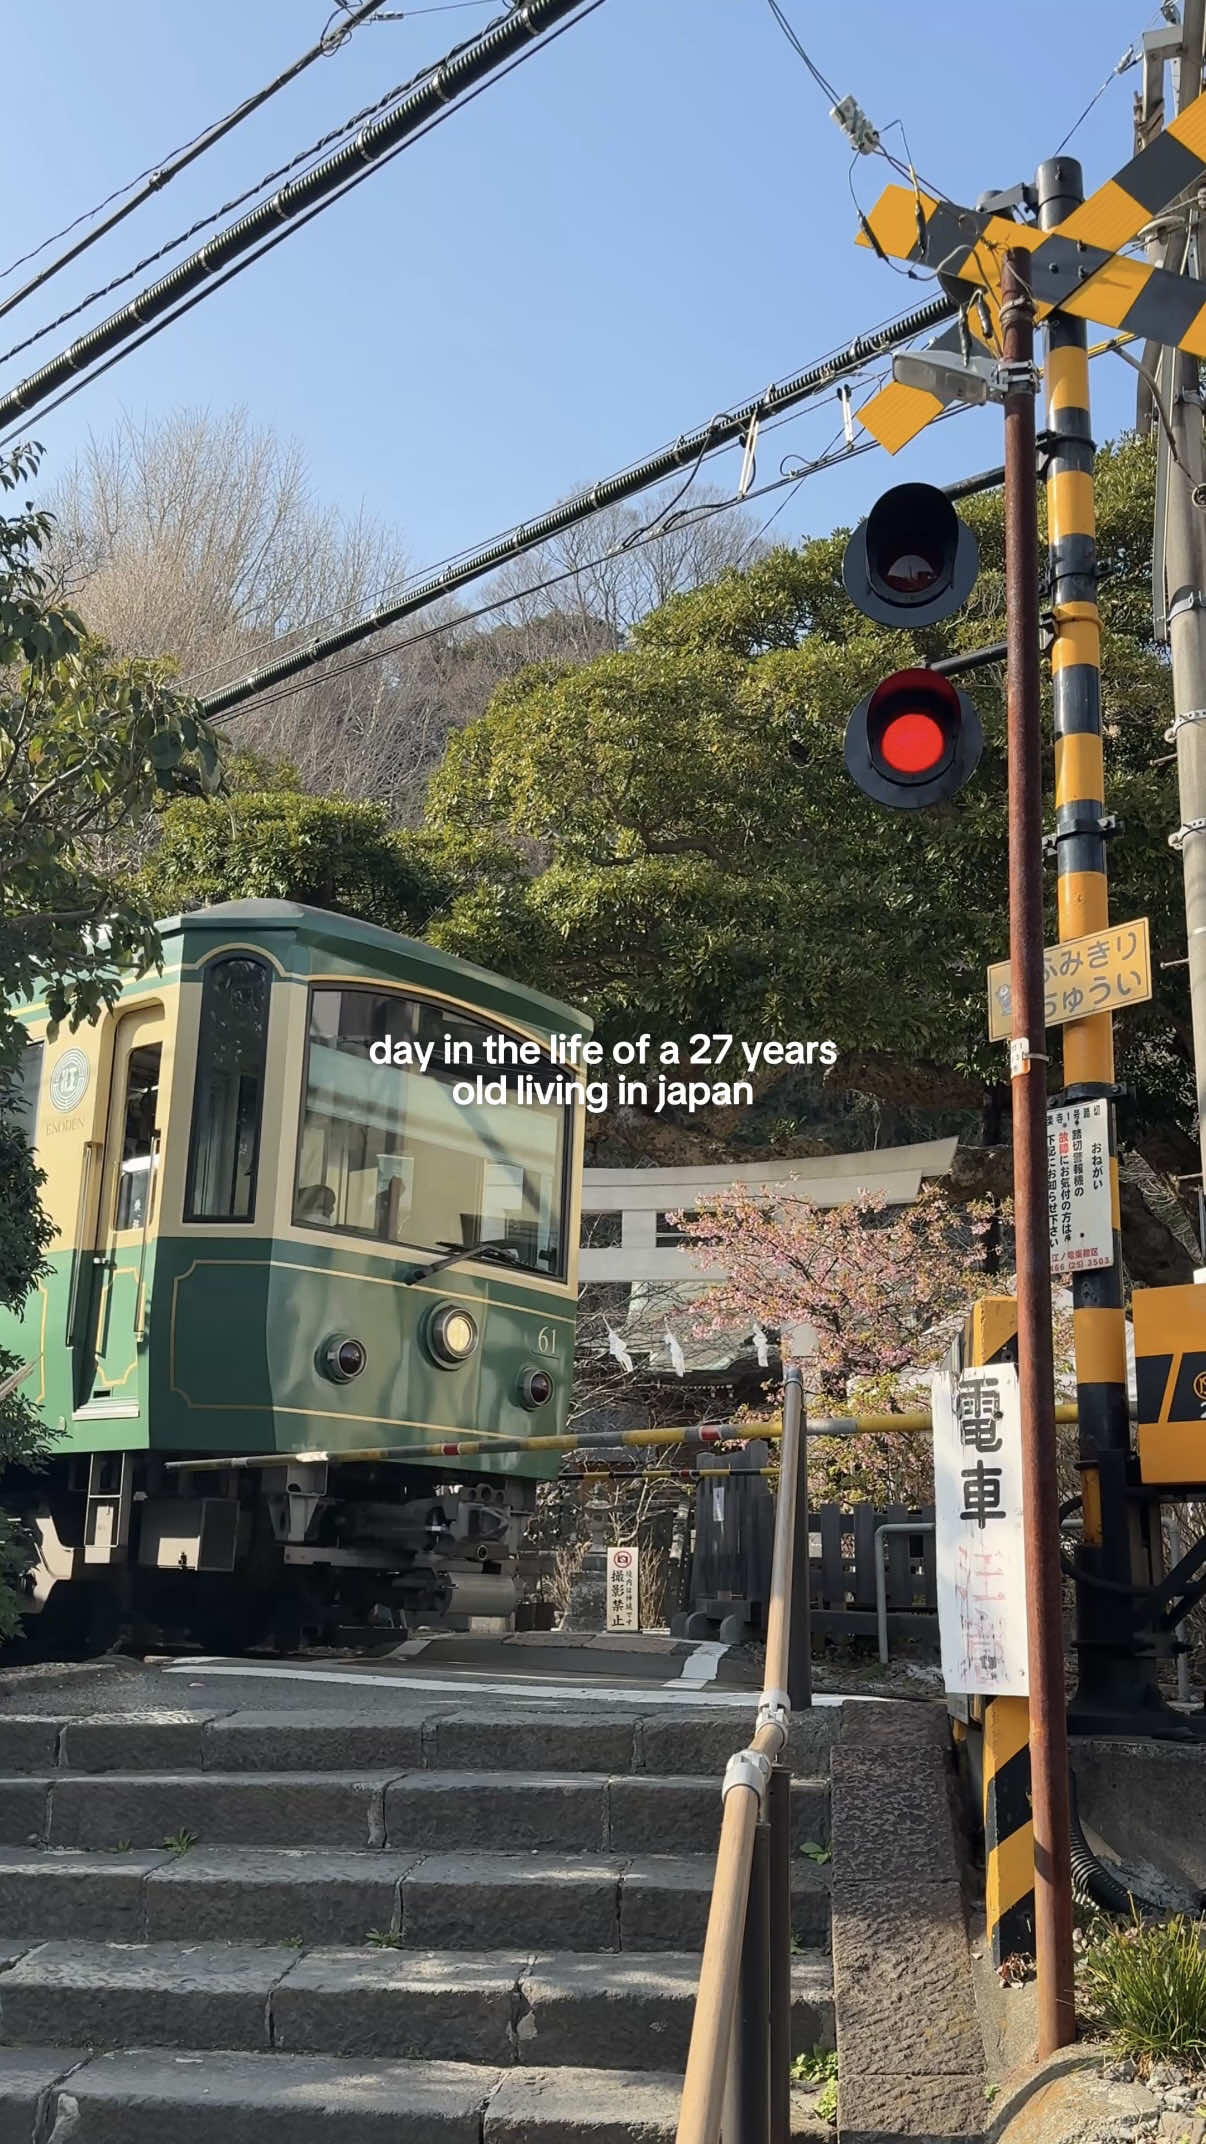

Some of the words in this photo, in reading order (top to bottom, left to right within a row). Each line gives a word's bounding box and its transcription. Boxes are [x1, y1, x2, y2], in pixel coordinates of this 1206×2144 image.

[1091, 1142, 1104, 1190] おねがい
[538, 1326, 557, 1354] 61
[611, 1569, 625, 1627] 撮影禁止
